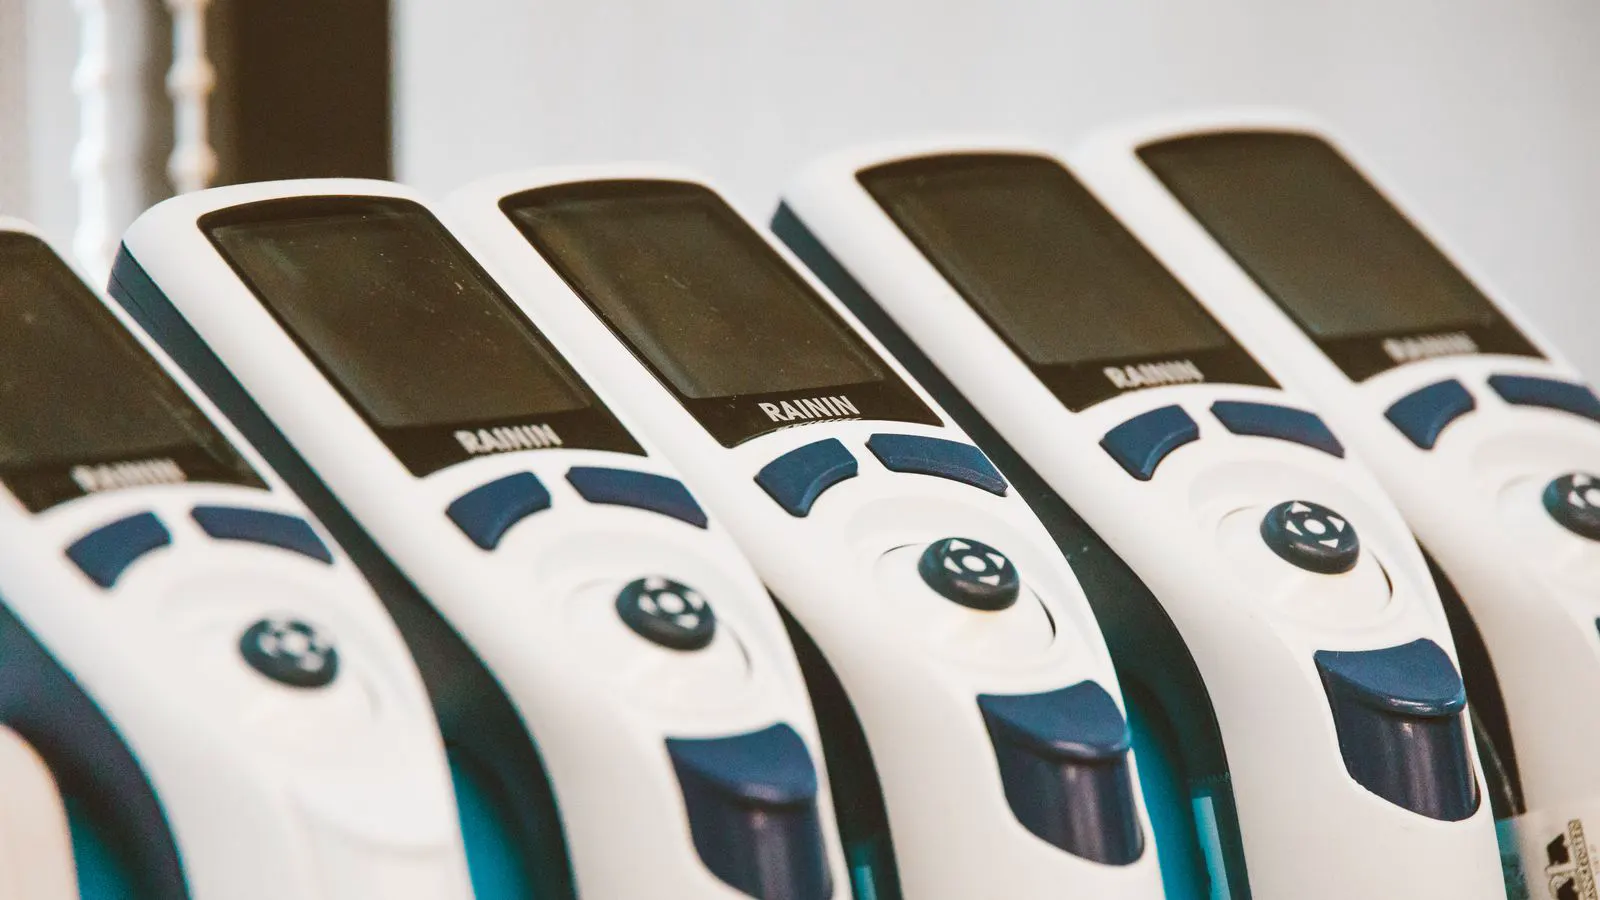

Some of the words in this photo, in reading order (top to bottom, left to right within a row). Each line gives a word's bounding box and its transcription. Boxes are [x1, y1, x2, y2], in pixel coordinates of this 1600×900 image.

[1103, 360, 1204, 388] RAININ
[758, 395, 861, 422] RAININ
[455, 424, 562, 454] RAININ
